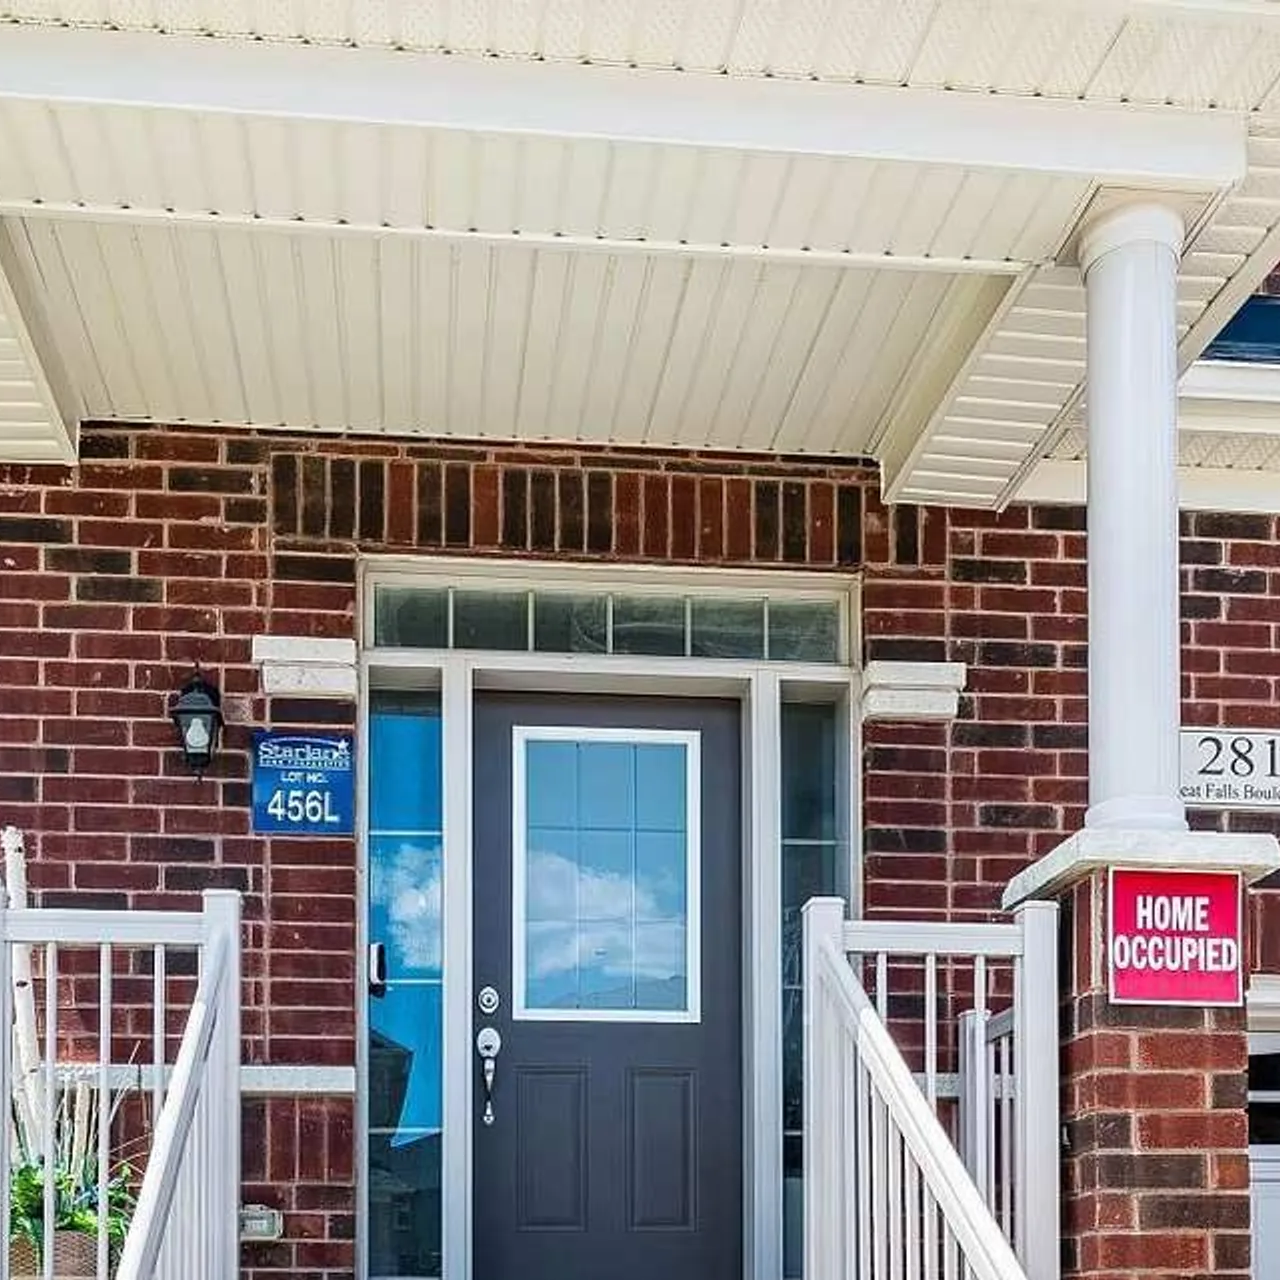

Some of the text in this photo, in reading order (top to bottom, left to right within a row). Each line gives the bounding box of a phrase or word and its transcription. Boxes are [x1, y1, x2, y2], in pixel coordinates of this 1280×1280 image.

[1197, 736, 1280, 777] 281
[267, 789, 340, 822] 456L
[1205, 783, 1239, 799] Falls
[1136, 895, 1210, 931] HOME
[1114, 934, 1238, 972] OCCUPIED
